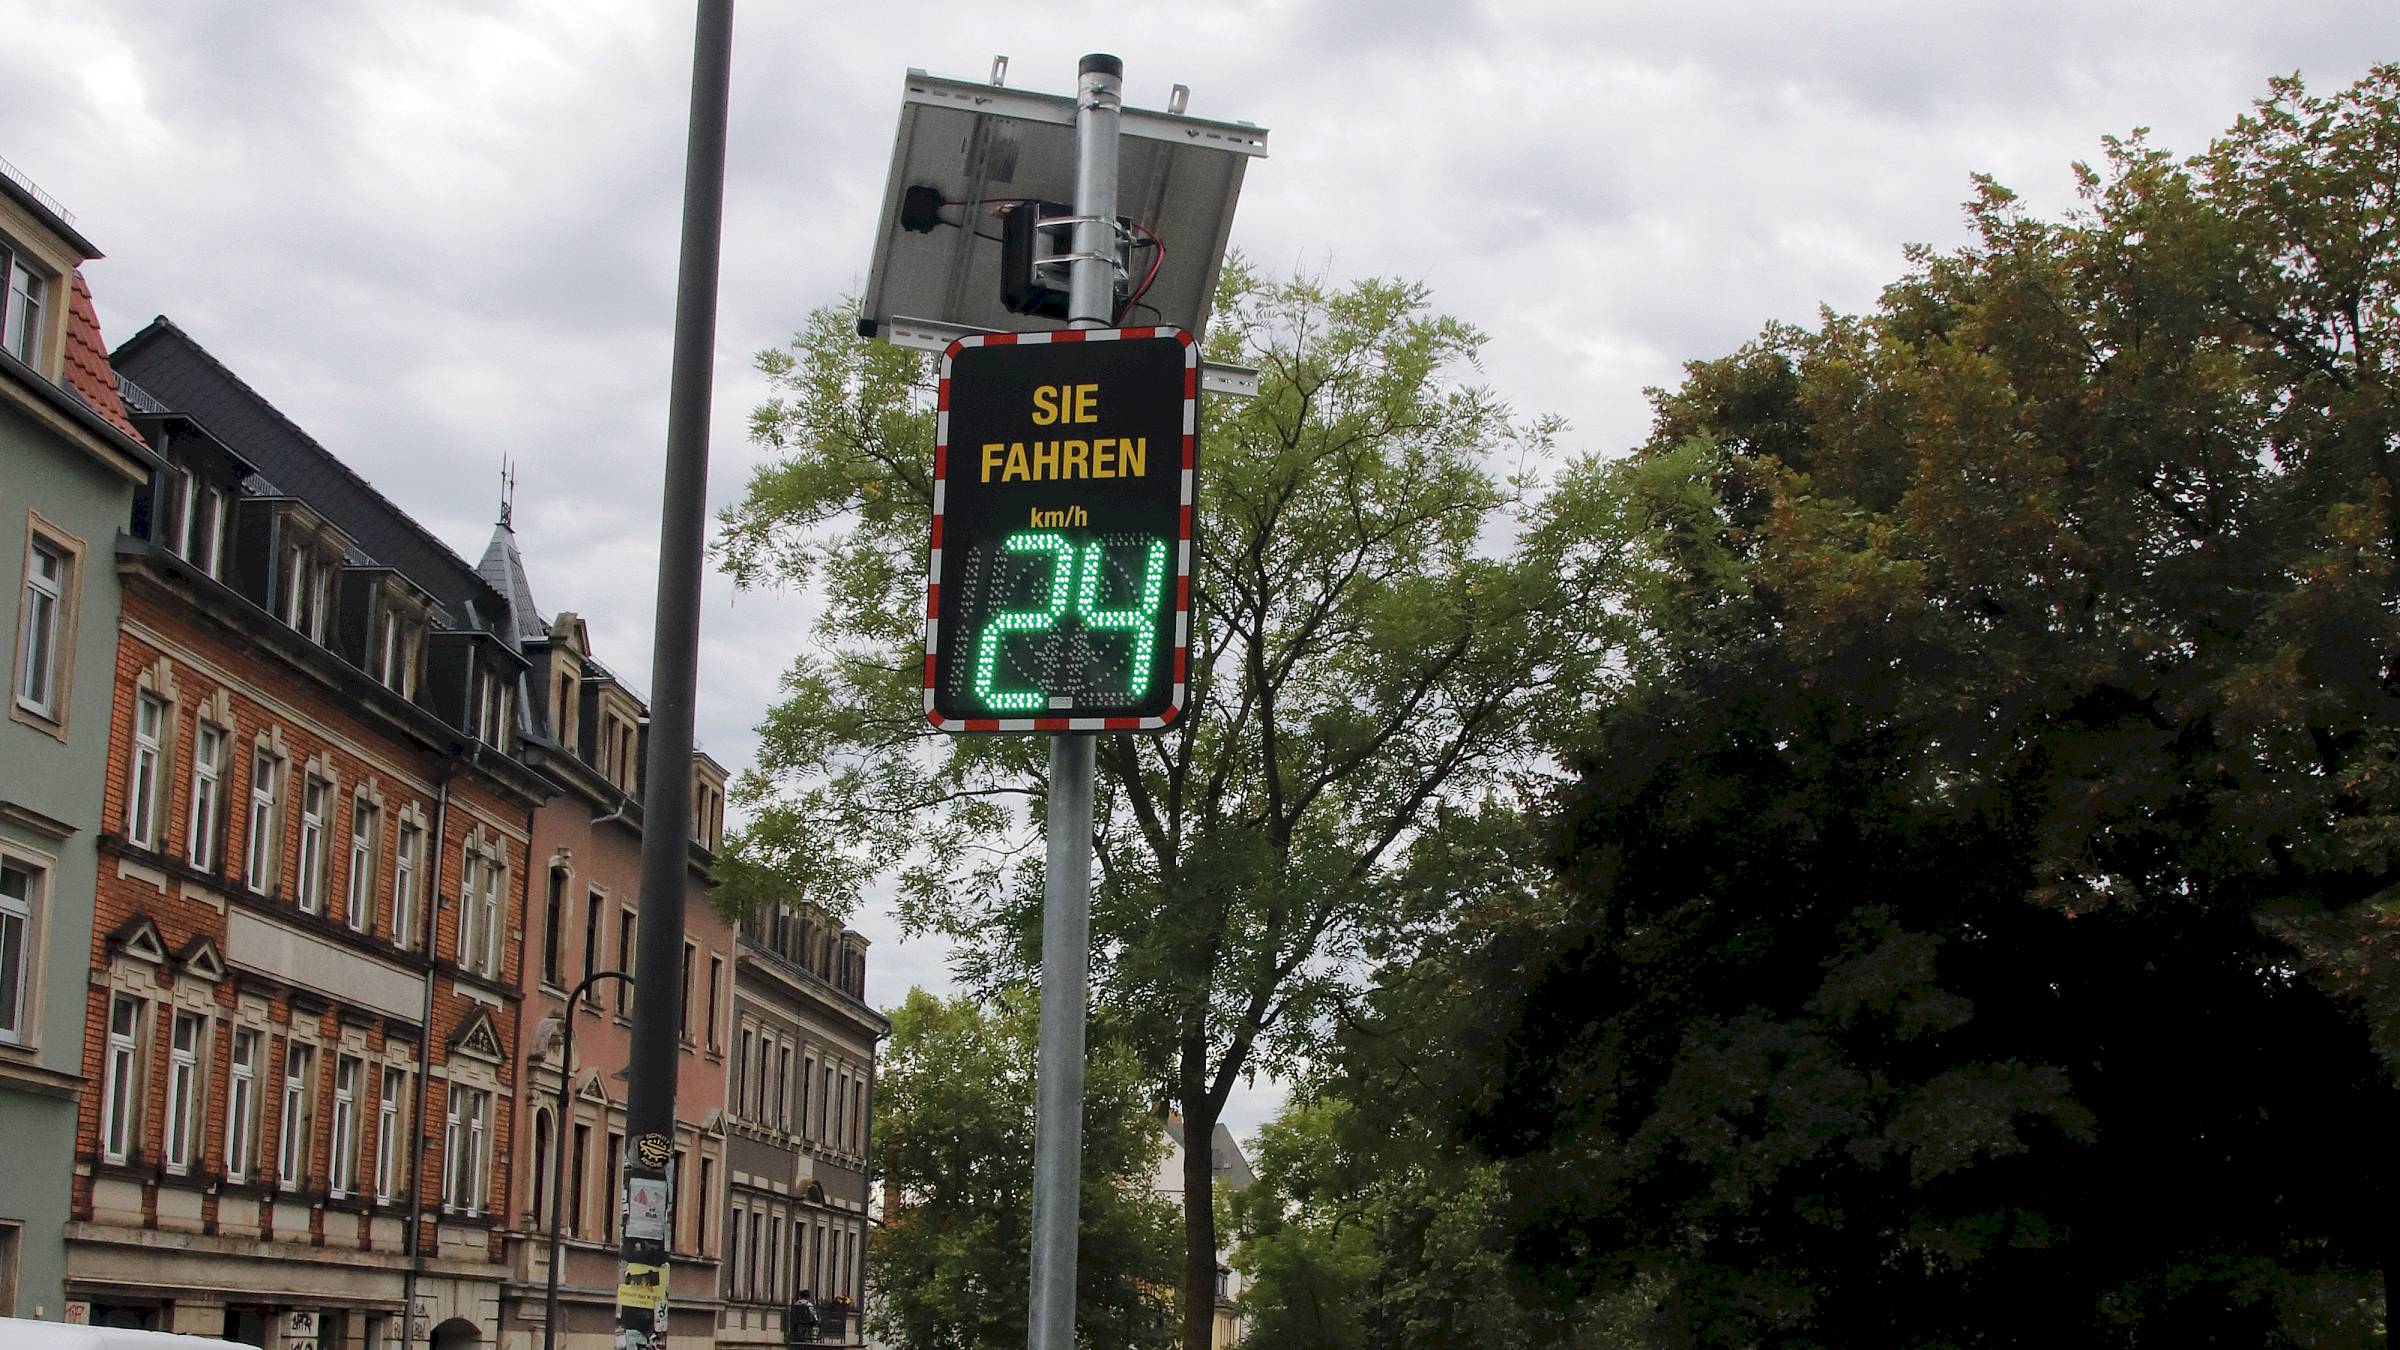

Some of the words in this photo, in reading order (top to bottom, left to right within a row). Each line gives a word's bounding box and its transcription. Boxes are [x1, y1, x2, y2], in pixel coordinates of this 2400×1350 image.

[1032, 384, 1099, 426] SIE
[981, 437, 1147, 483] FAHREN
[1030, 506, 1088, 529] km/h
[975, 533, 1167, 709] 24
